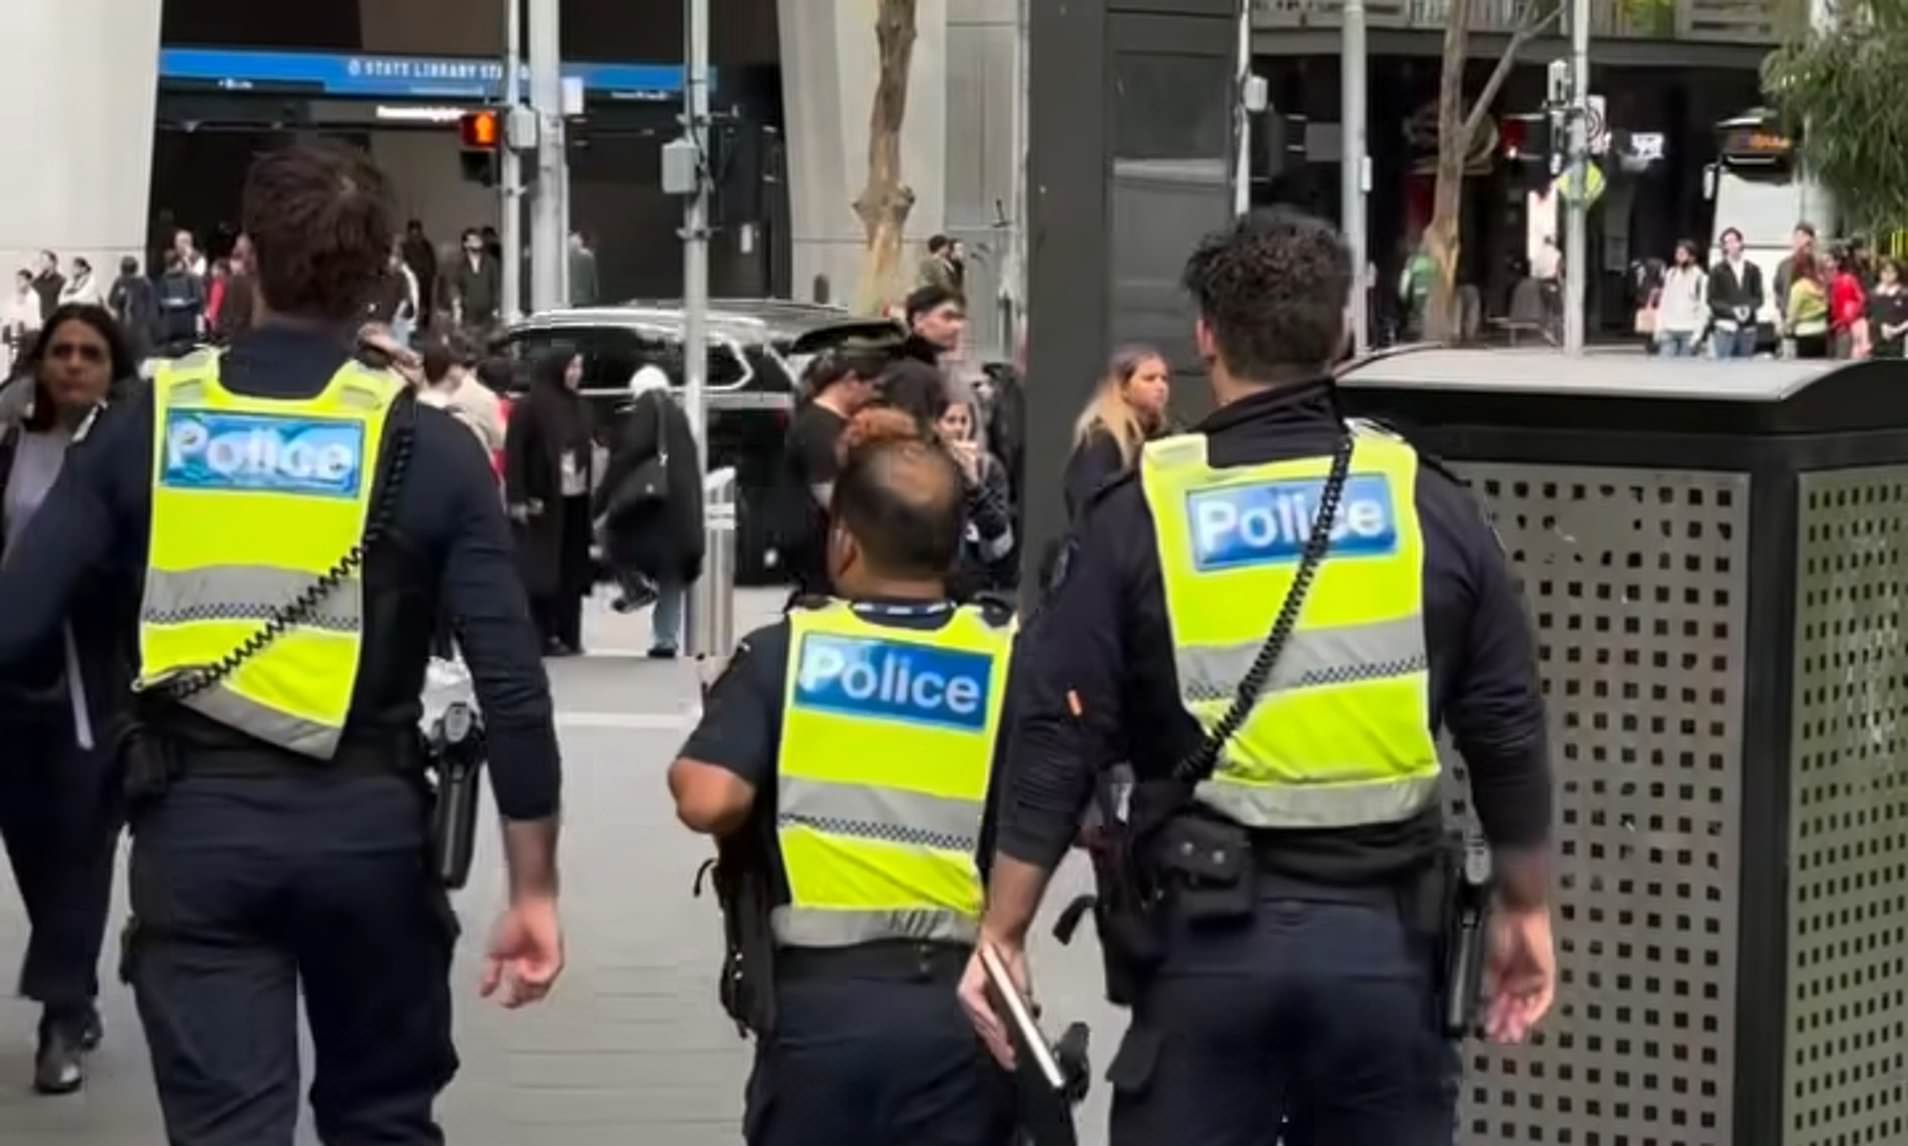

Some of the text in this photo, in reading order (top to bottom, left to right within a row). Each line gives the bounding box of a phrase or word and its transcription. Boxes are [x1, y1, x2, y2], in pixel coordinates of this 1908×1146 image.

[365, 60, 409, 76] STATE
[415, 62, 476, 78] LIBRARY
[168, 420, 354, 480] Police
[800, 646, 980, 715] Police
